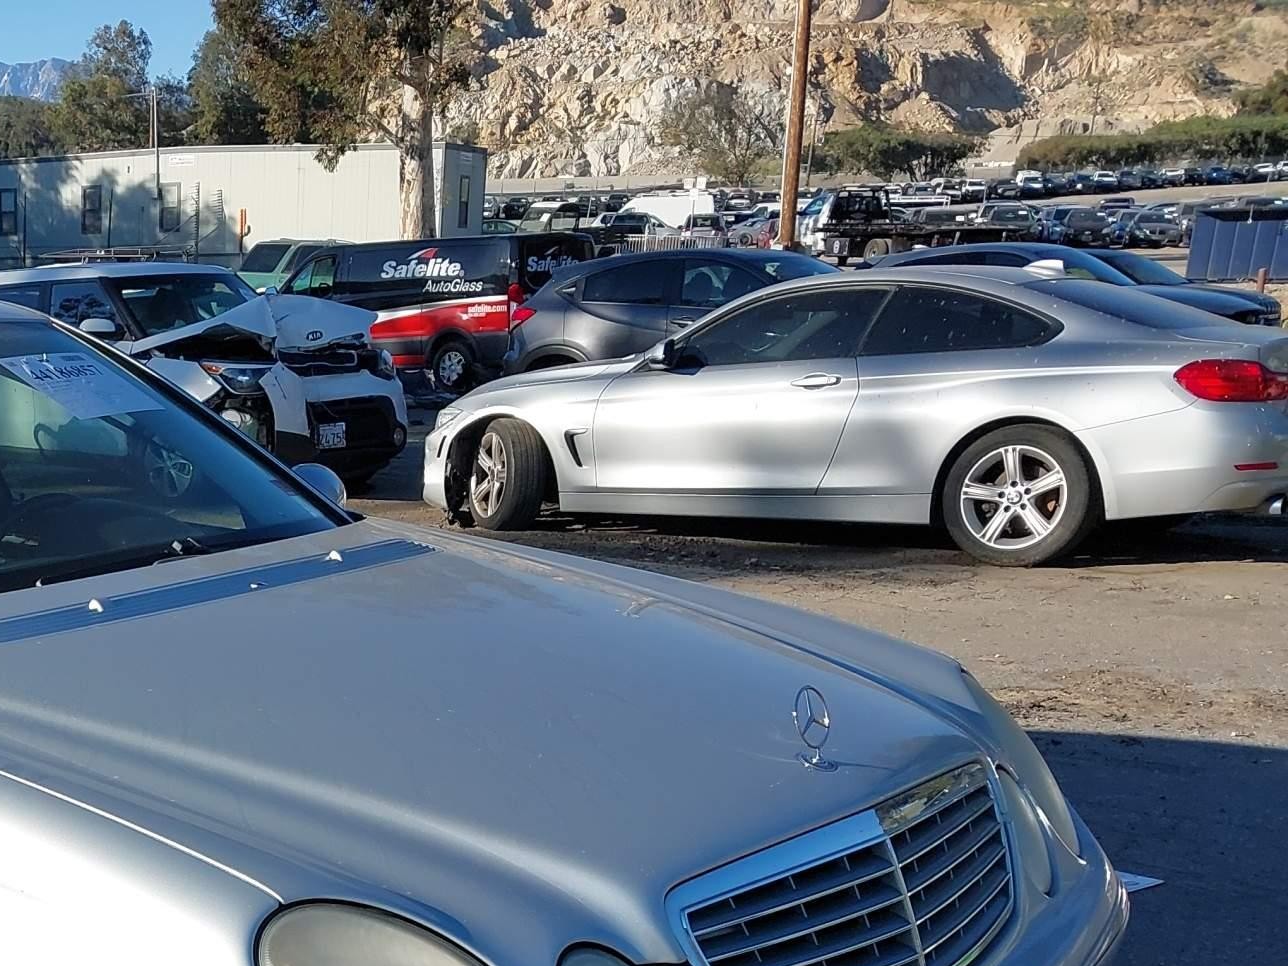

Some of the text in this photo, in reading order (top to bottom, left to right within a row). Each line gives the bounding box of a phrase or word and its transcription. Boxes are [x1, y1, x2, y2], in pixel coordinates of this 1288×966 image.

[381, 257, 462, 279] Safelite
[422, 279, 484, 293] AutoGlass
[467, 304, 508, 313] safelite.com
[308, 331, 322, 341] KIA
[30, 363, 105, 382] 44186857
